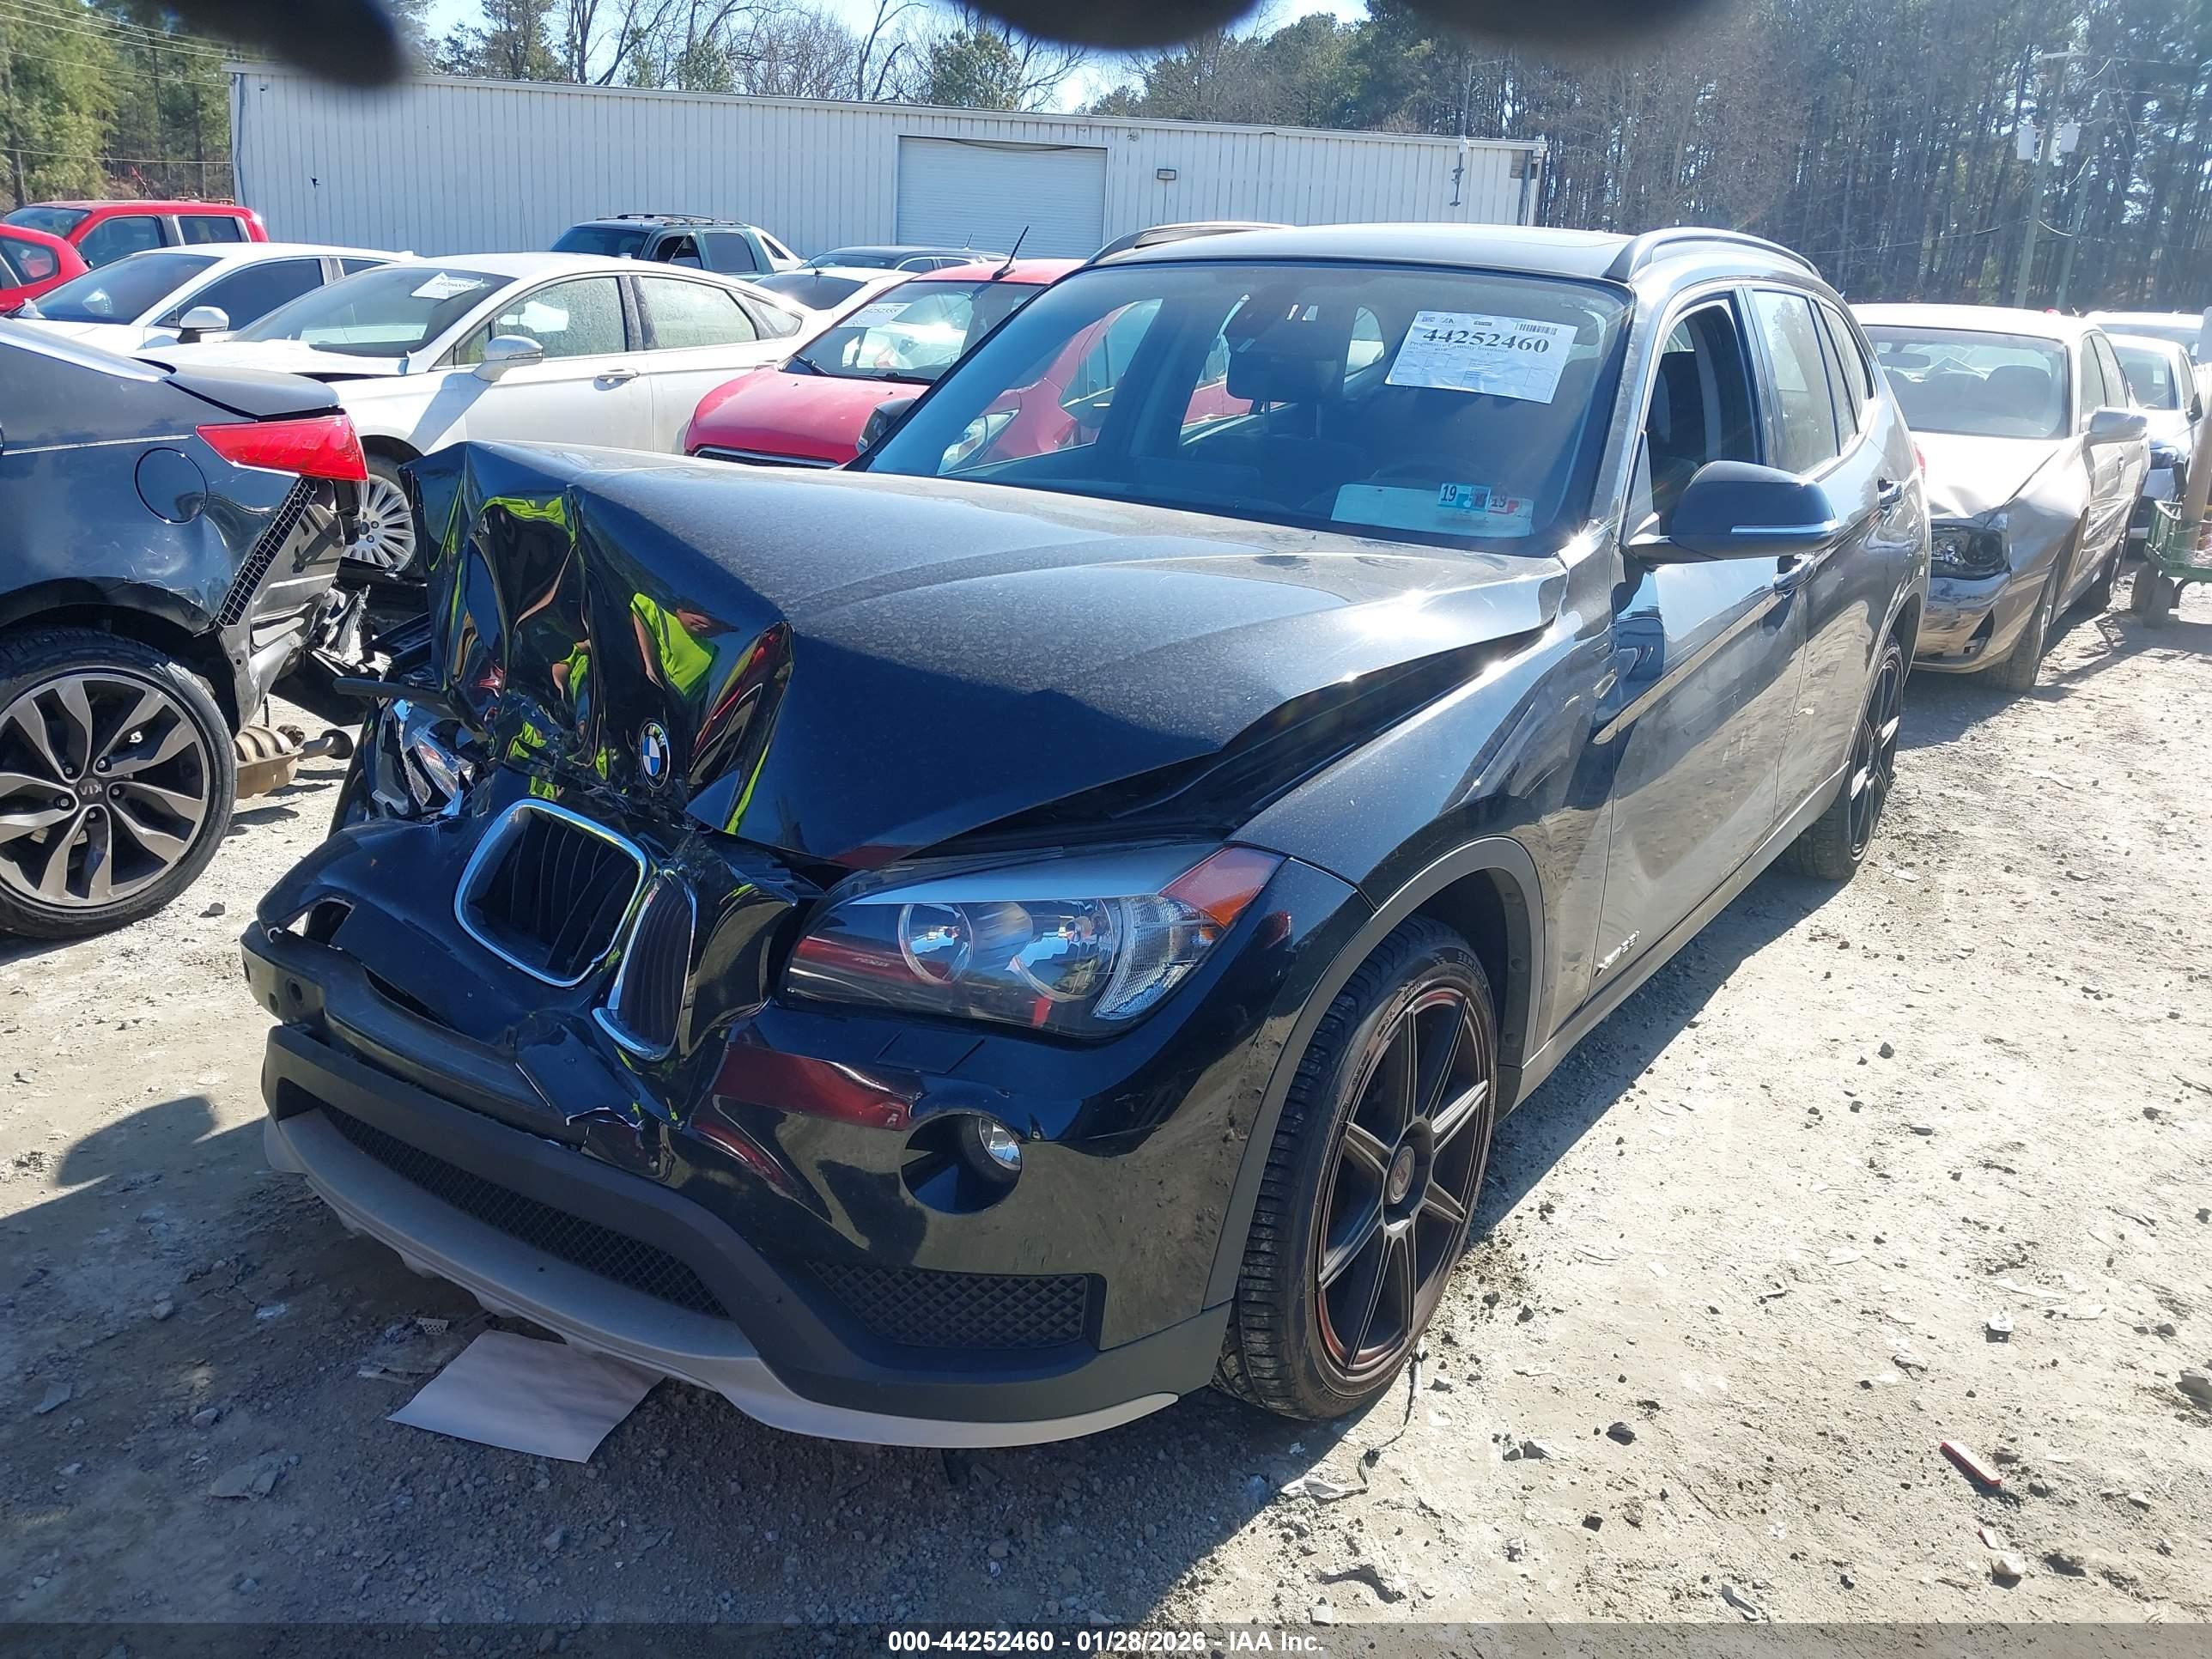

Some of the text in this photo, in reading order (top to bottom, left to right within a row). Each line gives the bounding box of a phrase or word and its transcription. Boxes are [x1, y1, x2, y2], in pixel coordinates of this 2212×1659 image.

[1423, 329, 1550, 354] 44252460
[1441, 484, 1457, 502] 19
[79, 783, 103, 795] KIA
